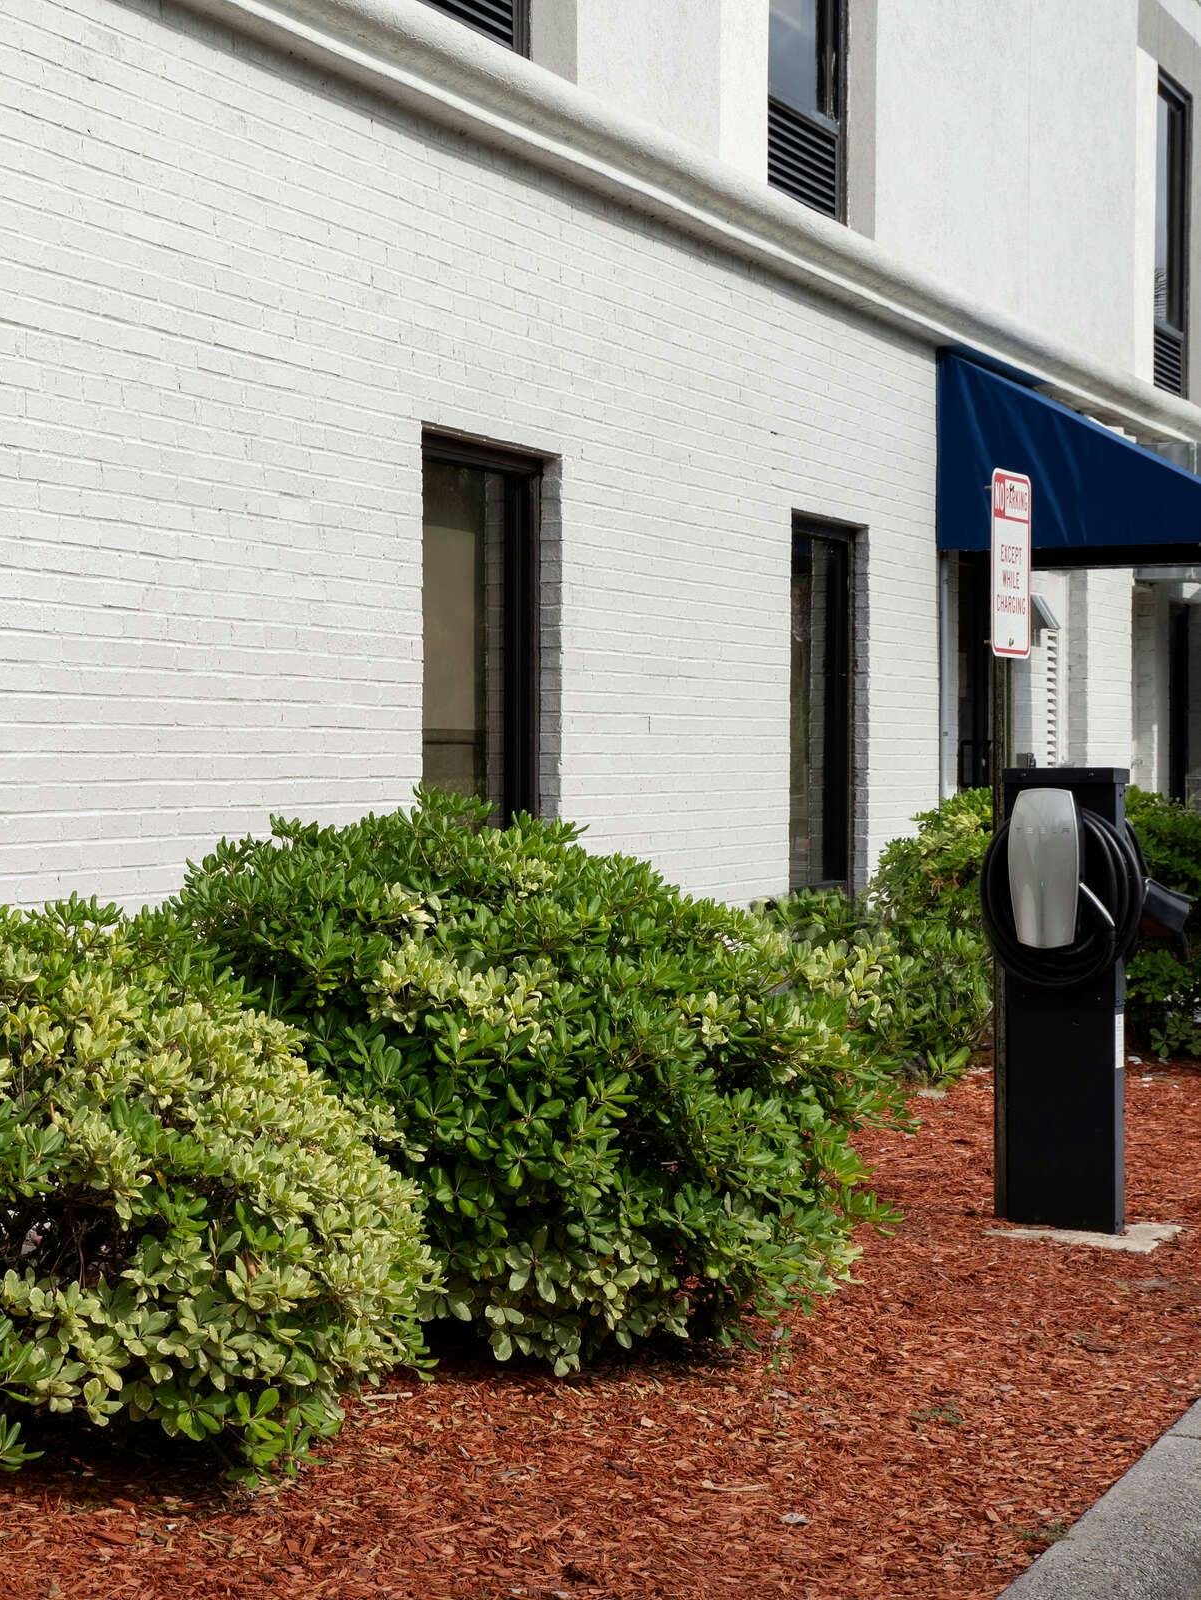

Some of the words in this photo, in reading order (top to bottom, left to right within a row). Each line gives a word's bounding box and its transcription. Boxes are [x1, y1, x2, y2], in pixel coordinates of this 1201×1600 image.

[995, 482, 1005, 511] NO
[1006, 486, 1028, 512] PARKING
[1001, 544, 1023, 565] EXCEPT
[1002, 571, 1020, 590] WHILE
[997, 594, 1026, 615] CHARGING
